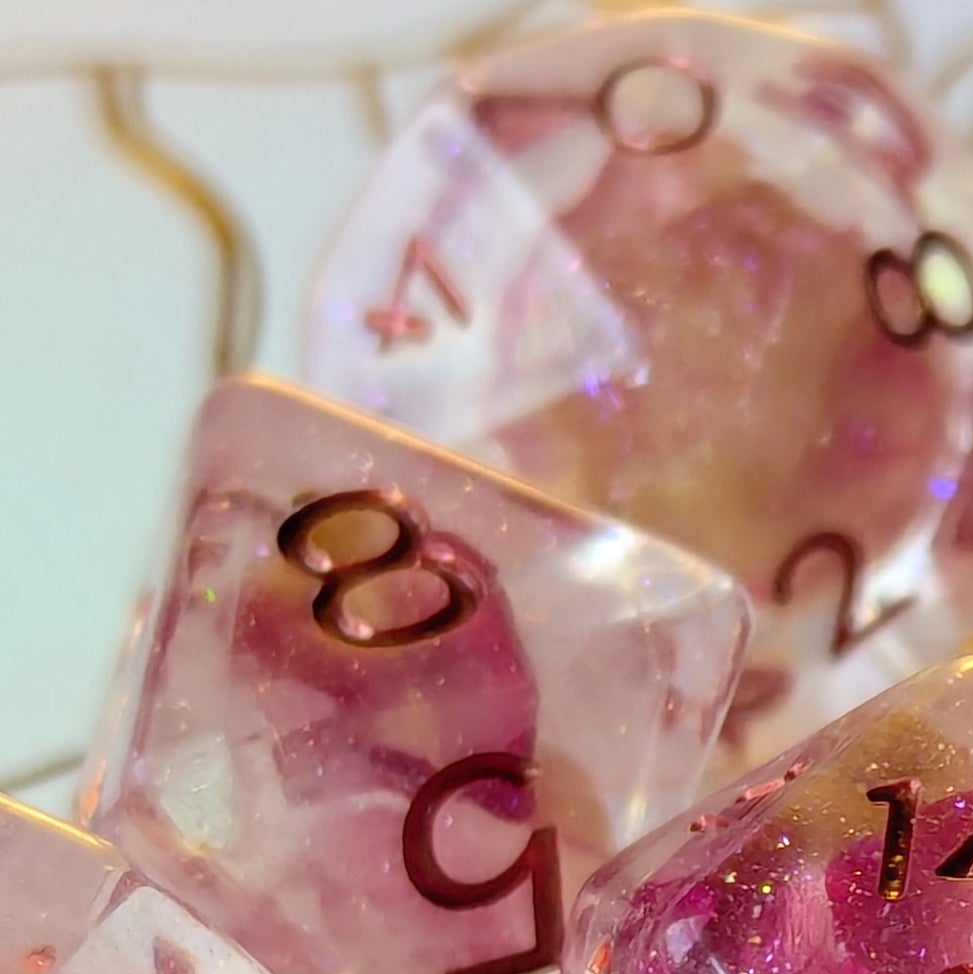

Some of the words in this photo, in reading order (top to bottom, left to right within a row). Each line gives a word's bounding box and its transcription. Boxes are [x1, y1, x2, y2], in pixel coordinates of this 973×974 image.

[363, 236, 473, 356] 4
[276, 488, 490, 647] 8
[770, 530, 920, 665] 2
